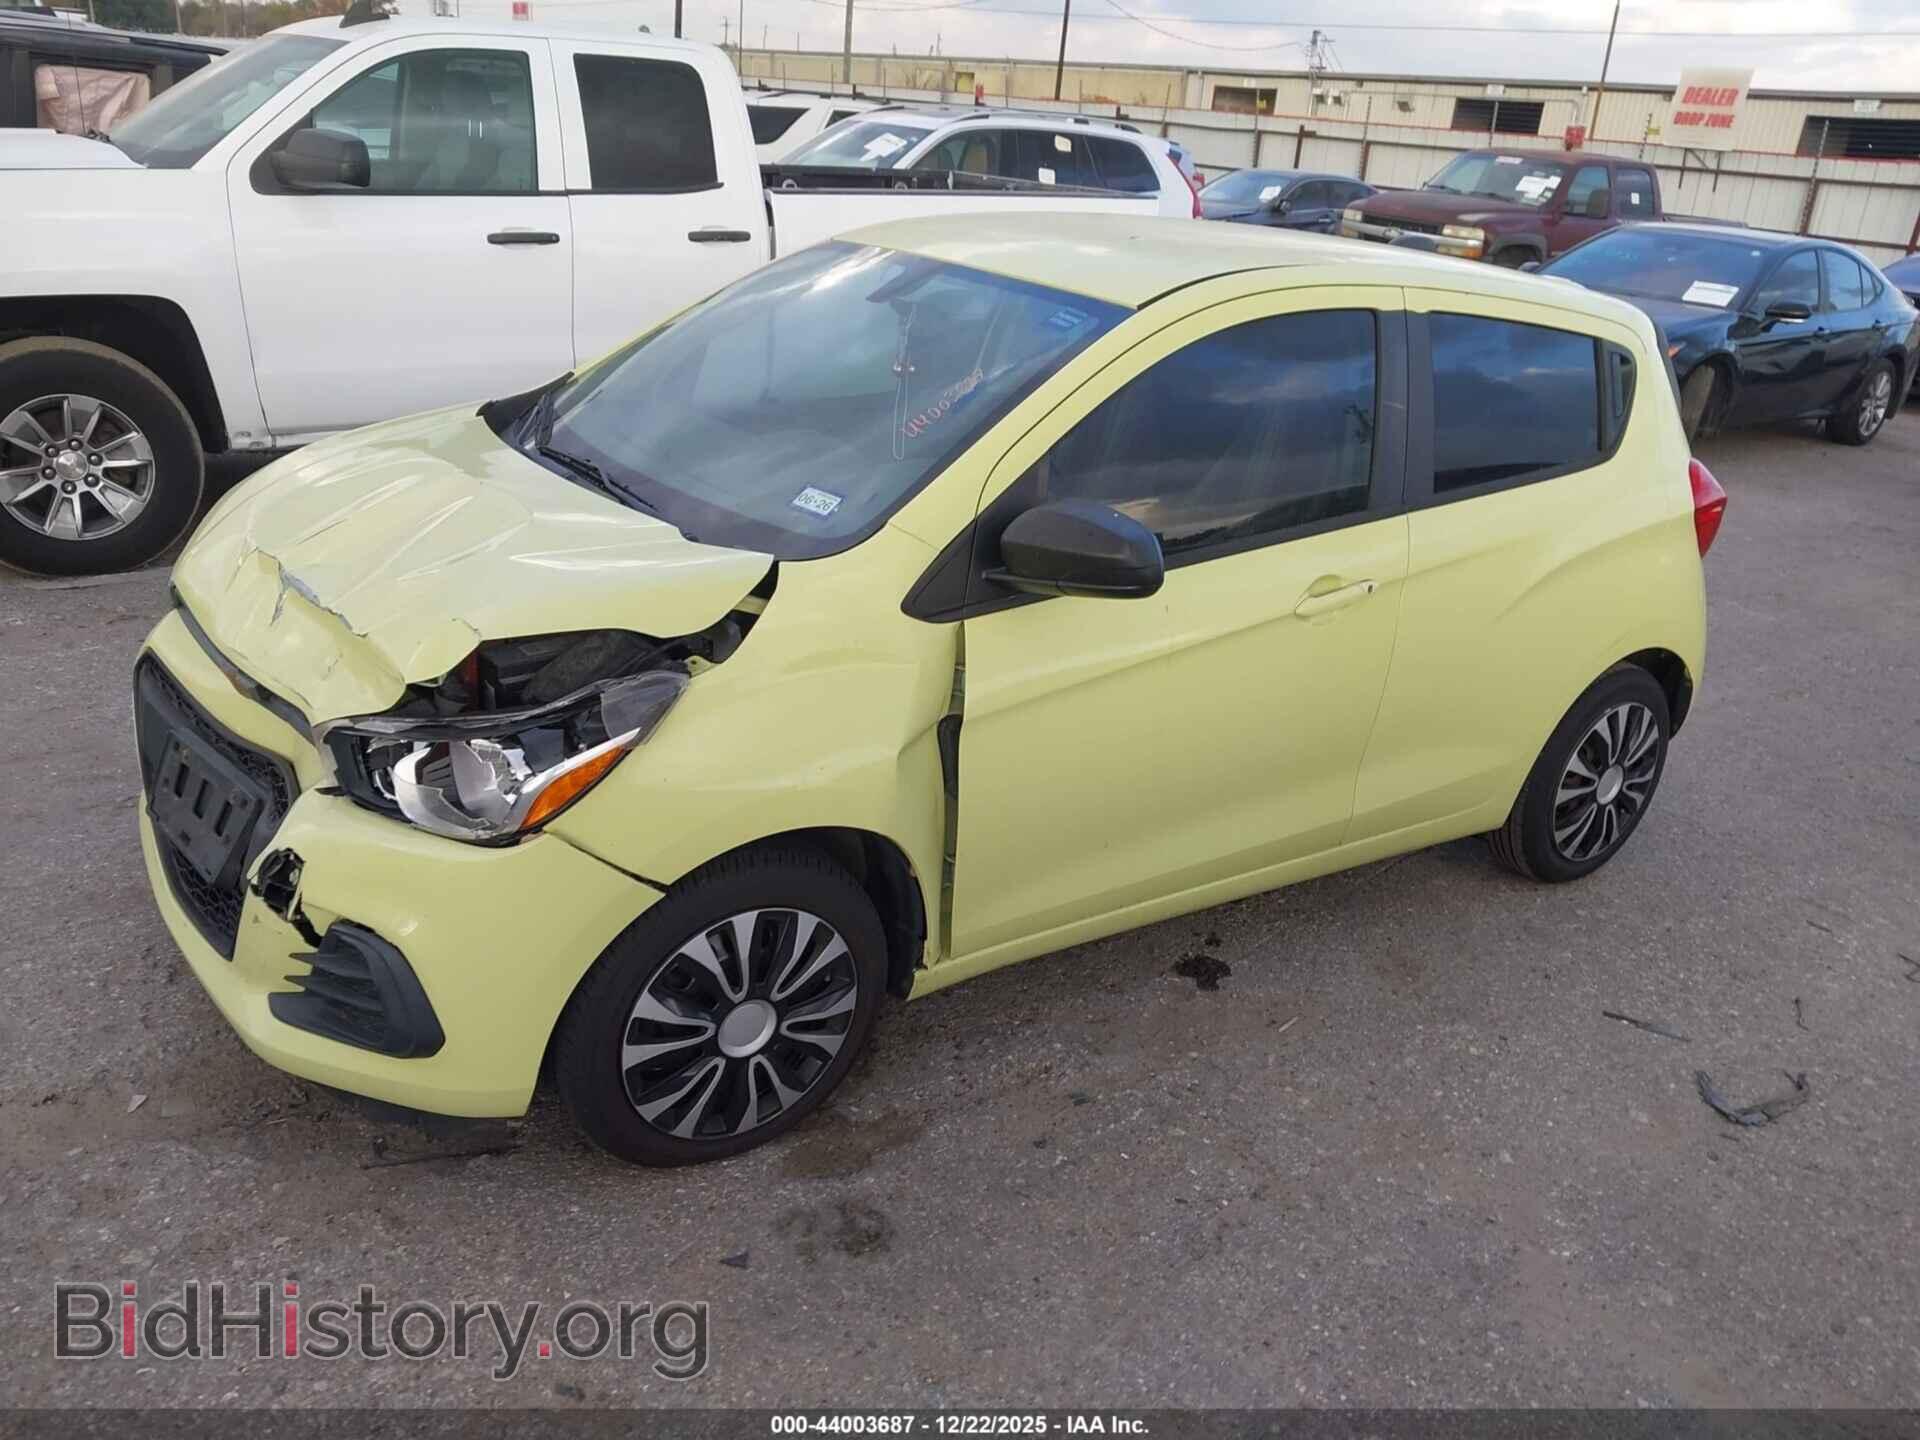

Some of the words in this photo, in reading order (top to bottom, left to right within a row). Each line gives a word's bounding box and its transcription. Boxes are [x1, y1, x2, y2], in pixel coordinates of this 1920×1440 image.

[1682, 86, 1739, 106] DEALER
[1673, 111, 1705, 126] DROP
[1704, 113, 1735, 128] ZONE
